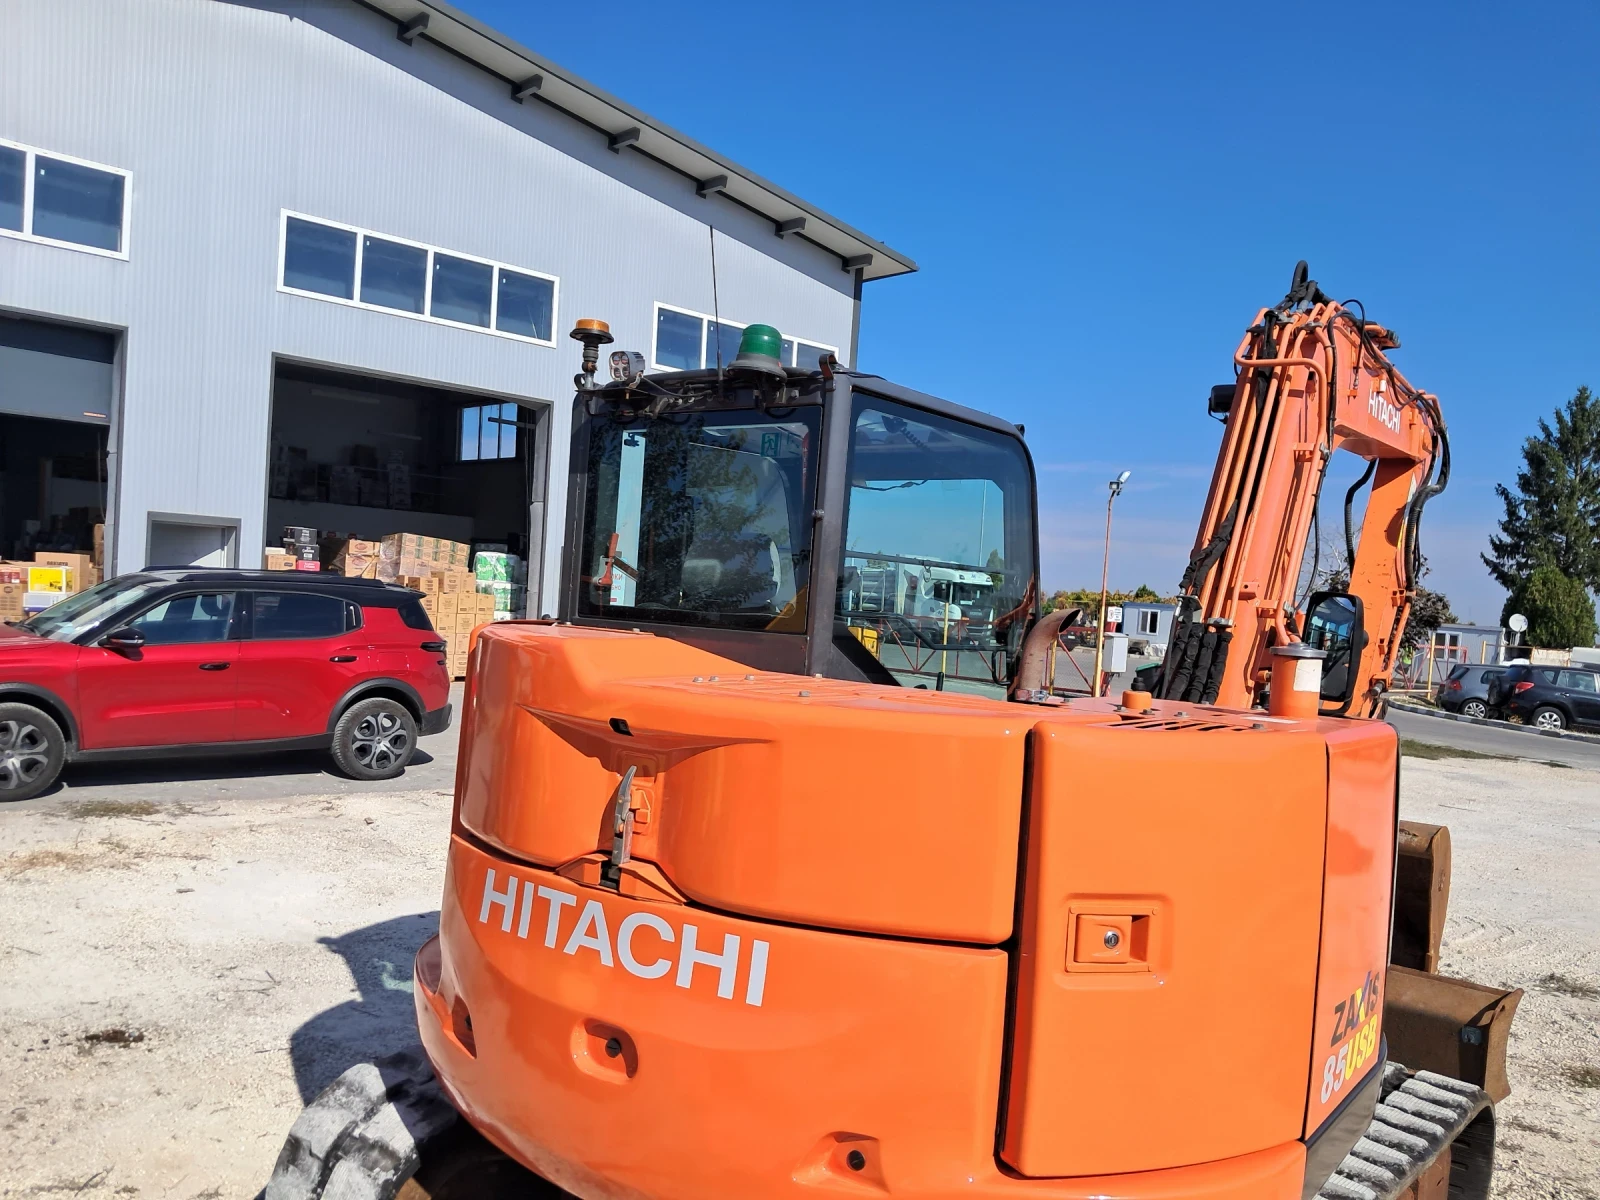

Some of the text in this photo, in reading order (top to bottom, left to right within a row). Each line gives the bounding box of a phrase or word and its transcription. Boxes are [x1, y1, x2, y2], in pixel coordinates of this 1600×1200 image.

[1368, 389, 1401, 434] HITACHI
[478, 868, 770, 1007] HITACHI
[1330, 970, 1381, 1048] ZAXIS
[1320, 1013, 1378, 1104] 85USB
